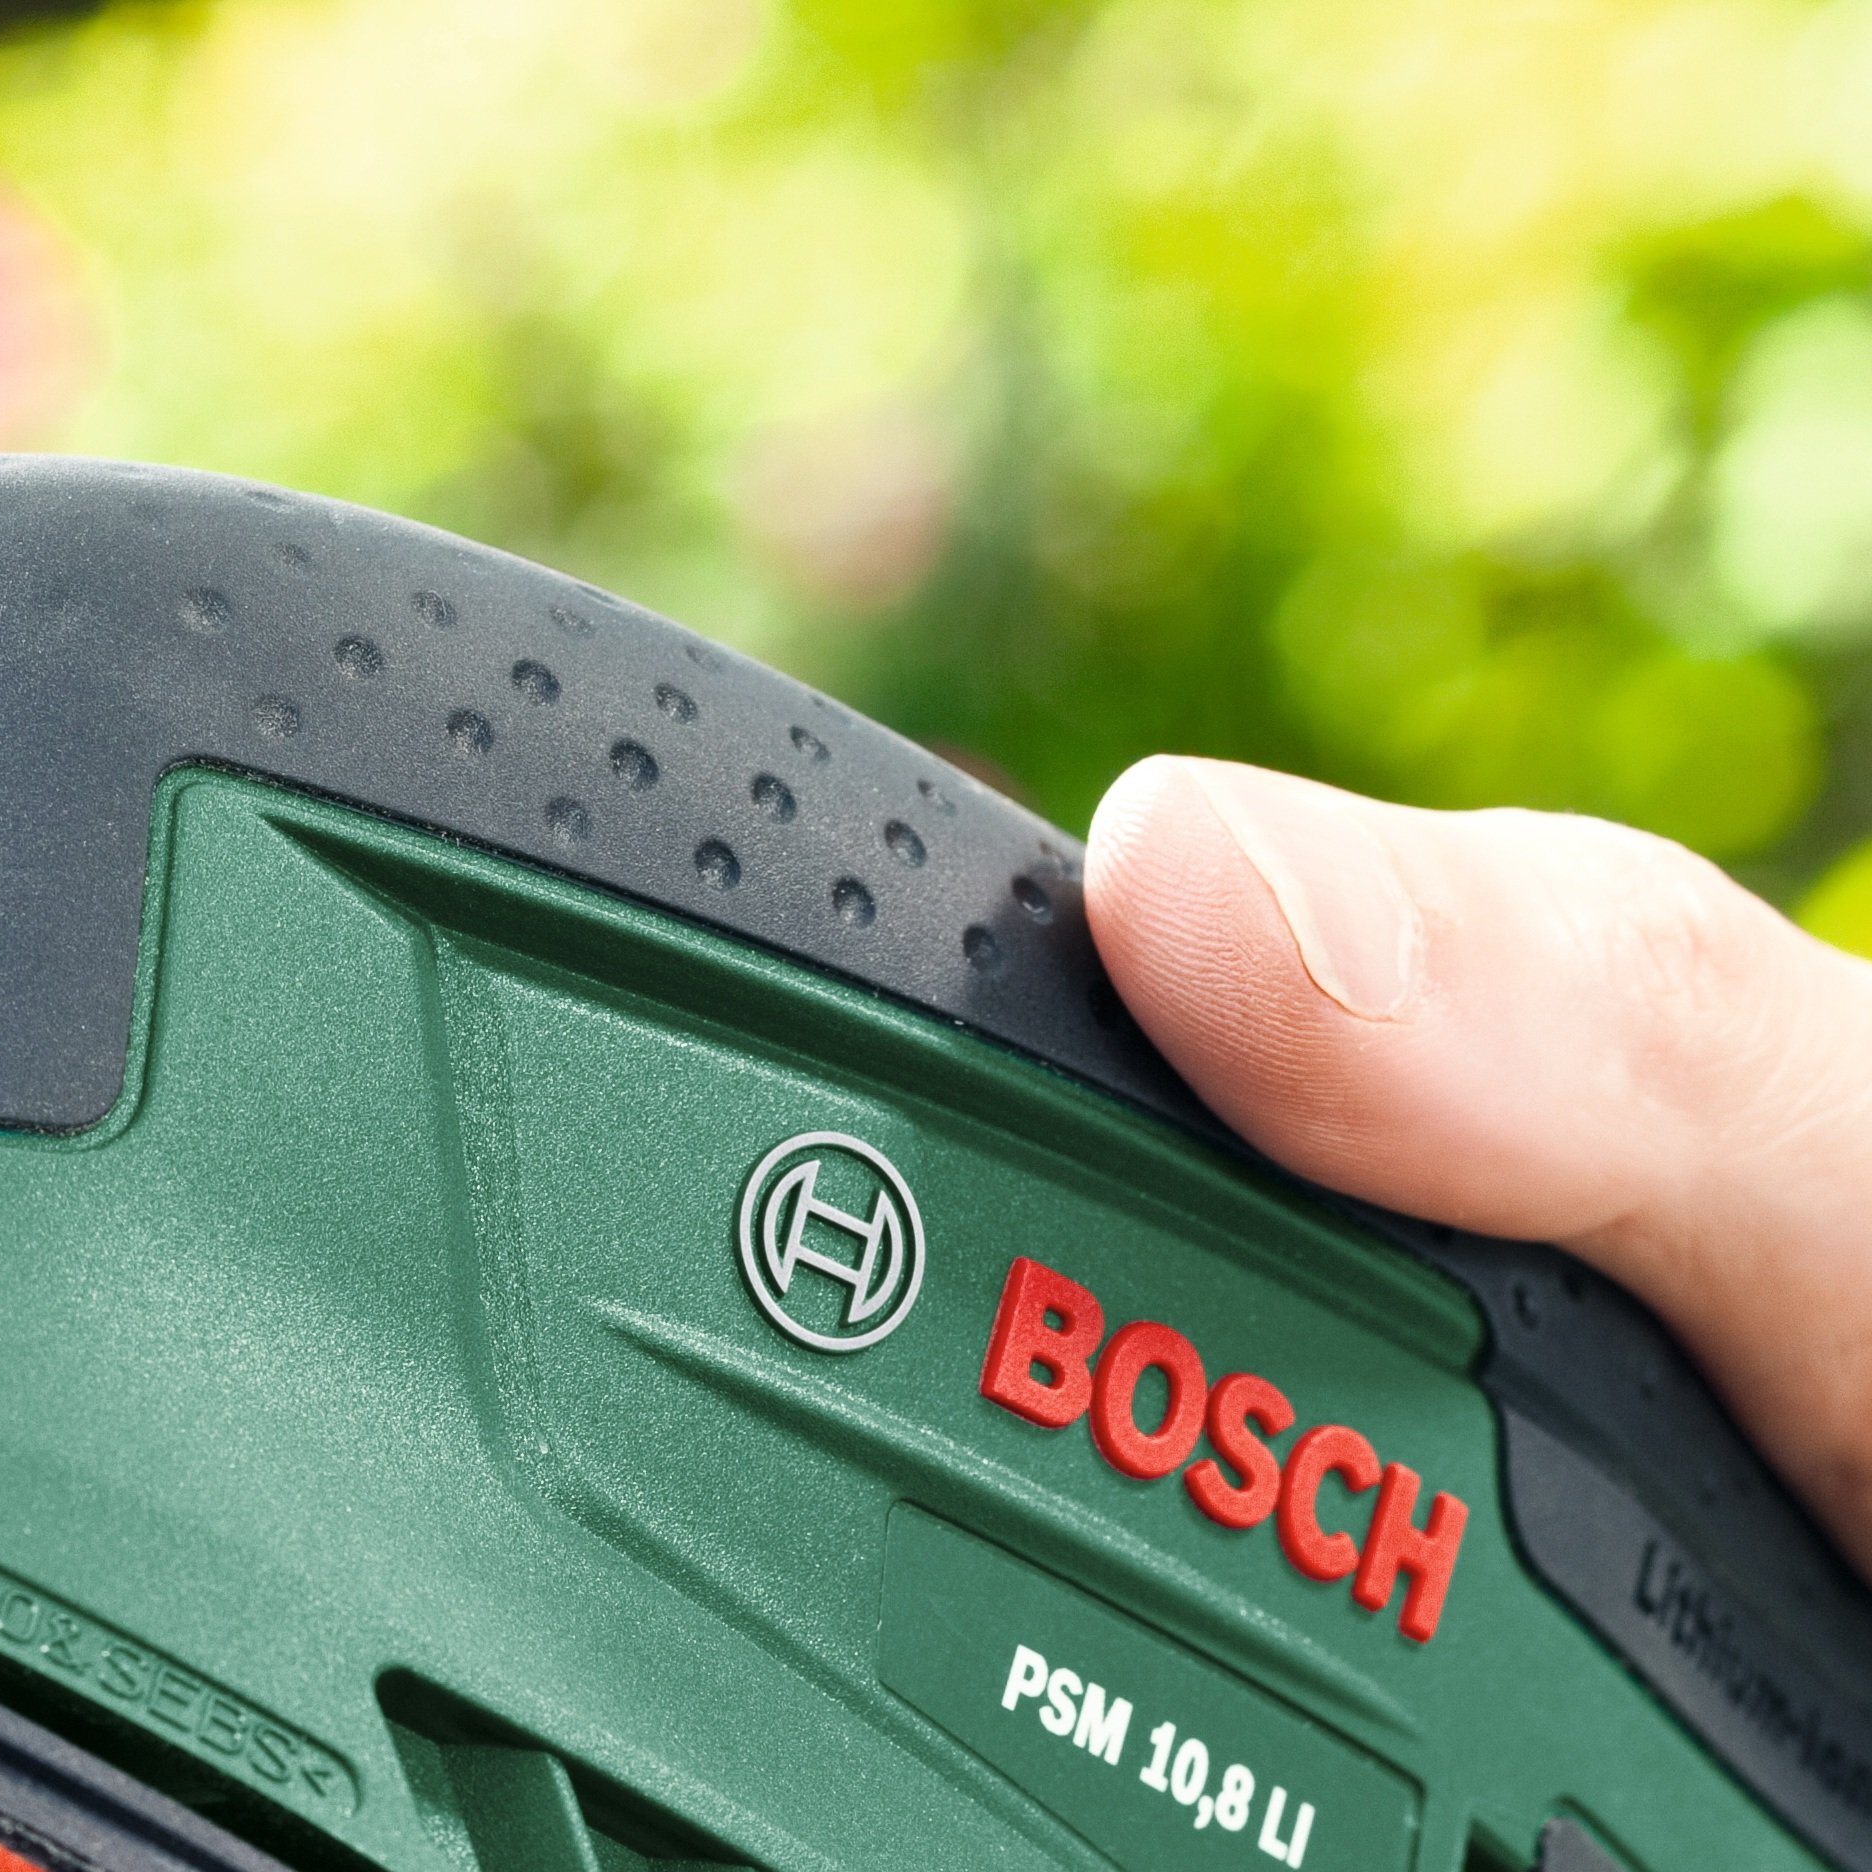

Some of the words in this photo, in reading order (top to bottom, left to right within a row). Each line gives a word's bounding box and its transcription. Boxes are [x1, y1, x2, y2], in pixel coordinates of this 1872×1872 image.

[979, 1256, 1469, 1644] BOSCH
[1001, 1644, 1134, 1766] PSM
[1139, 1721, 1255, 1832] 10,8
[1258, 1786, 1315, 1869] LI
